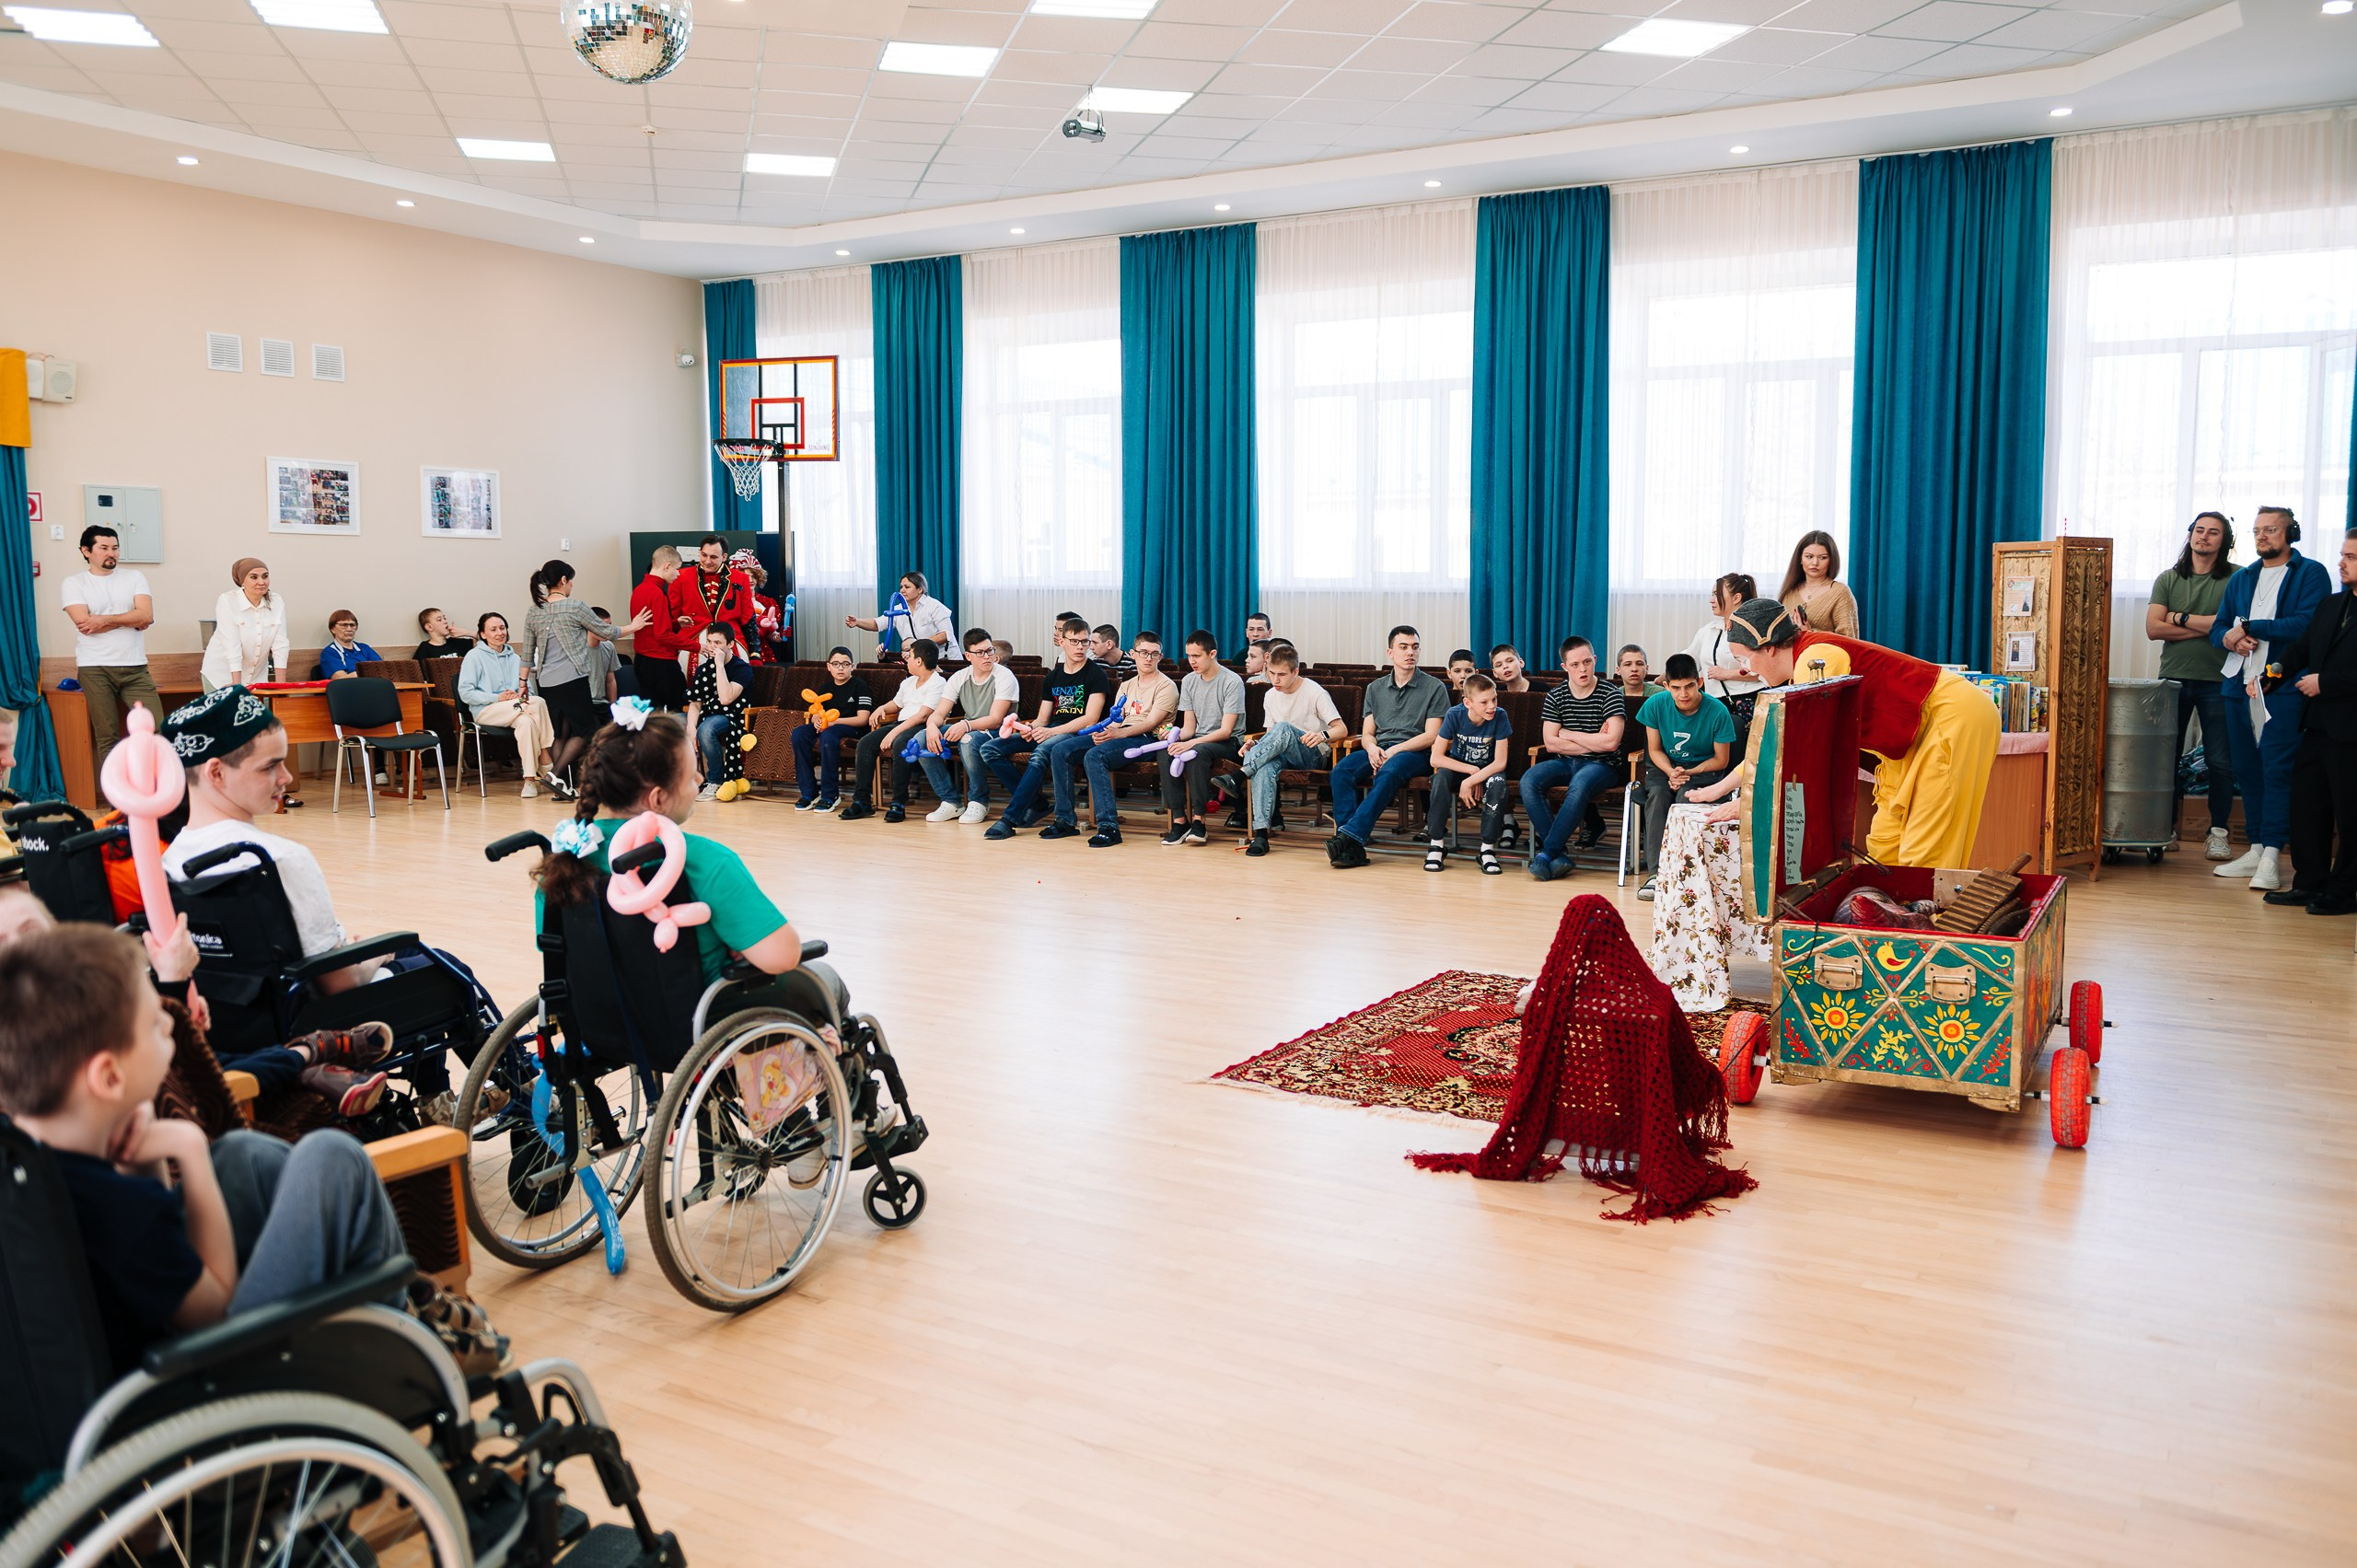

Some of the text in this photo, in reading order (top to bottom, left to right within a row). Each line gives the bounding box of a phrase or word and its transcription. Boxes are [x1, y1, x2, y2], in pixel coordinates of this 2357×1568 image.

[1051, 686, 1077, 696] KENZO
[1468, 736, 1482, 744] YORK
[1673, 731, 1691, 751] 7
[21, 835, 50, 852] bock.
[191, 933, 223, 945] tonica
